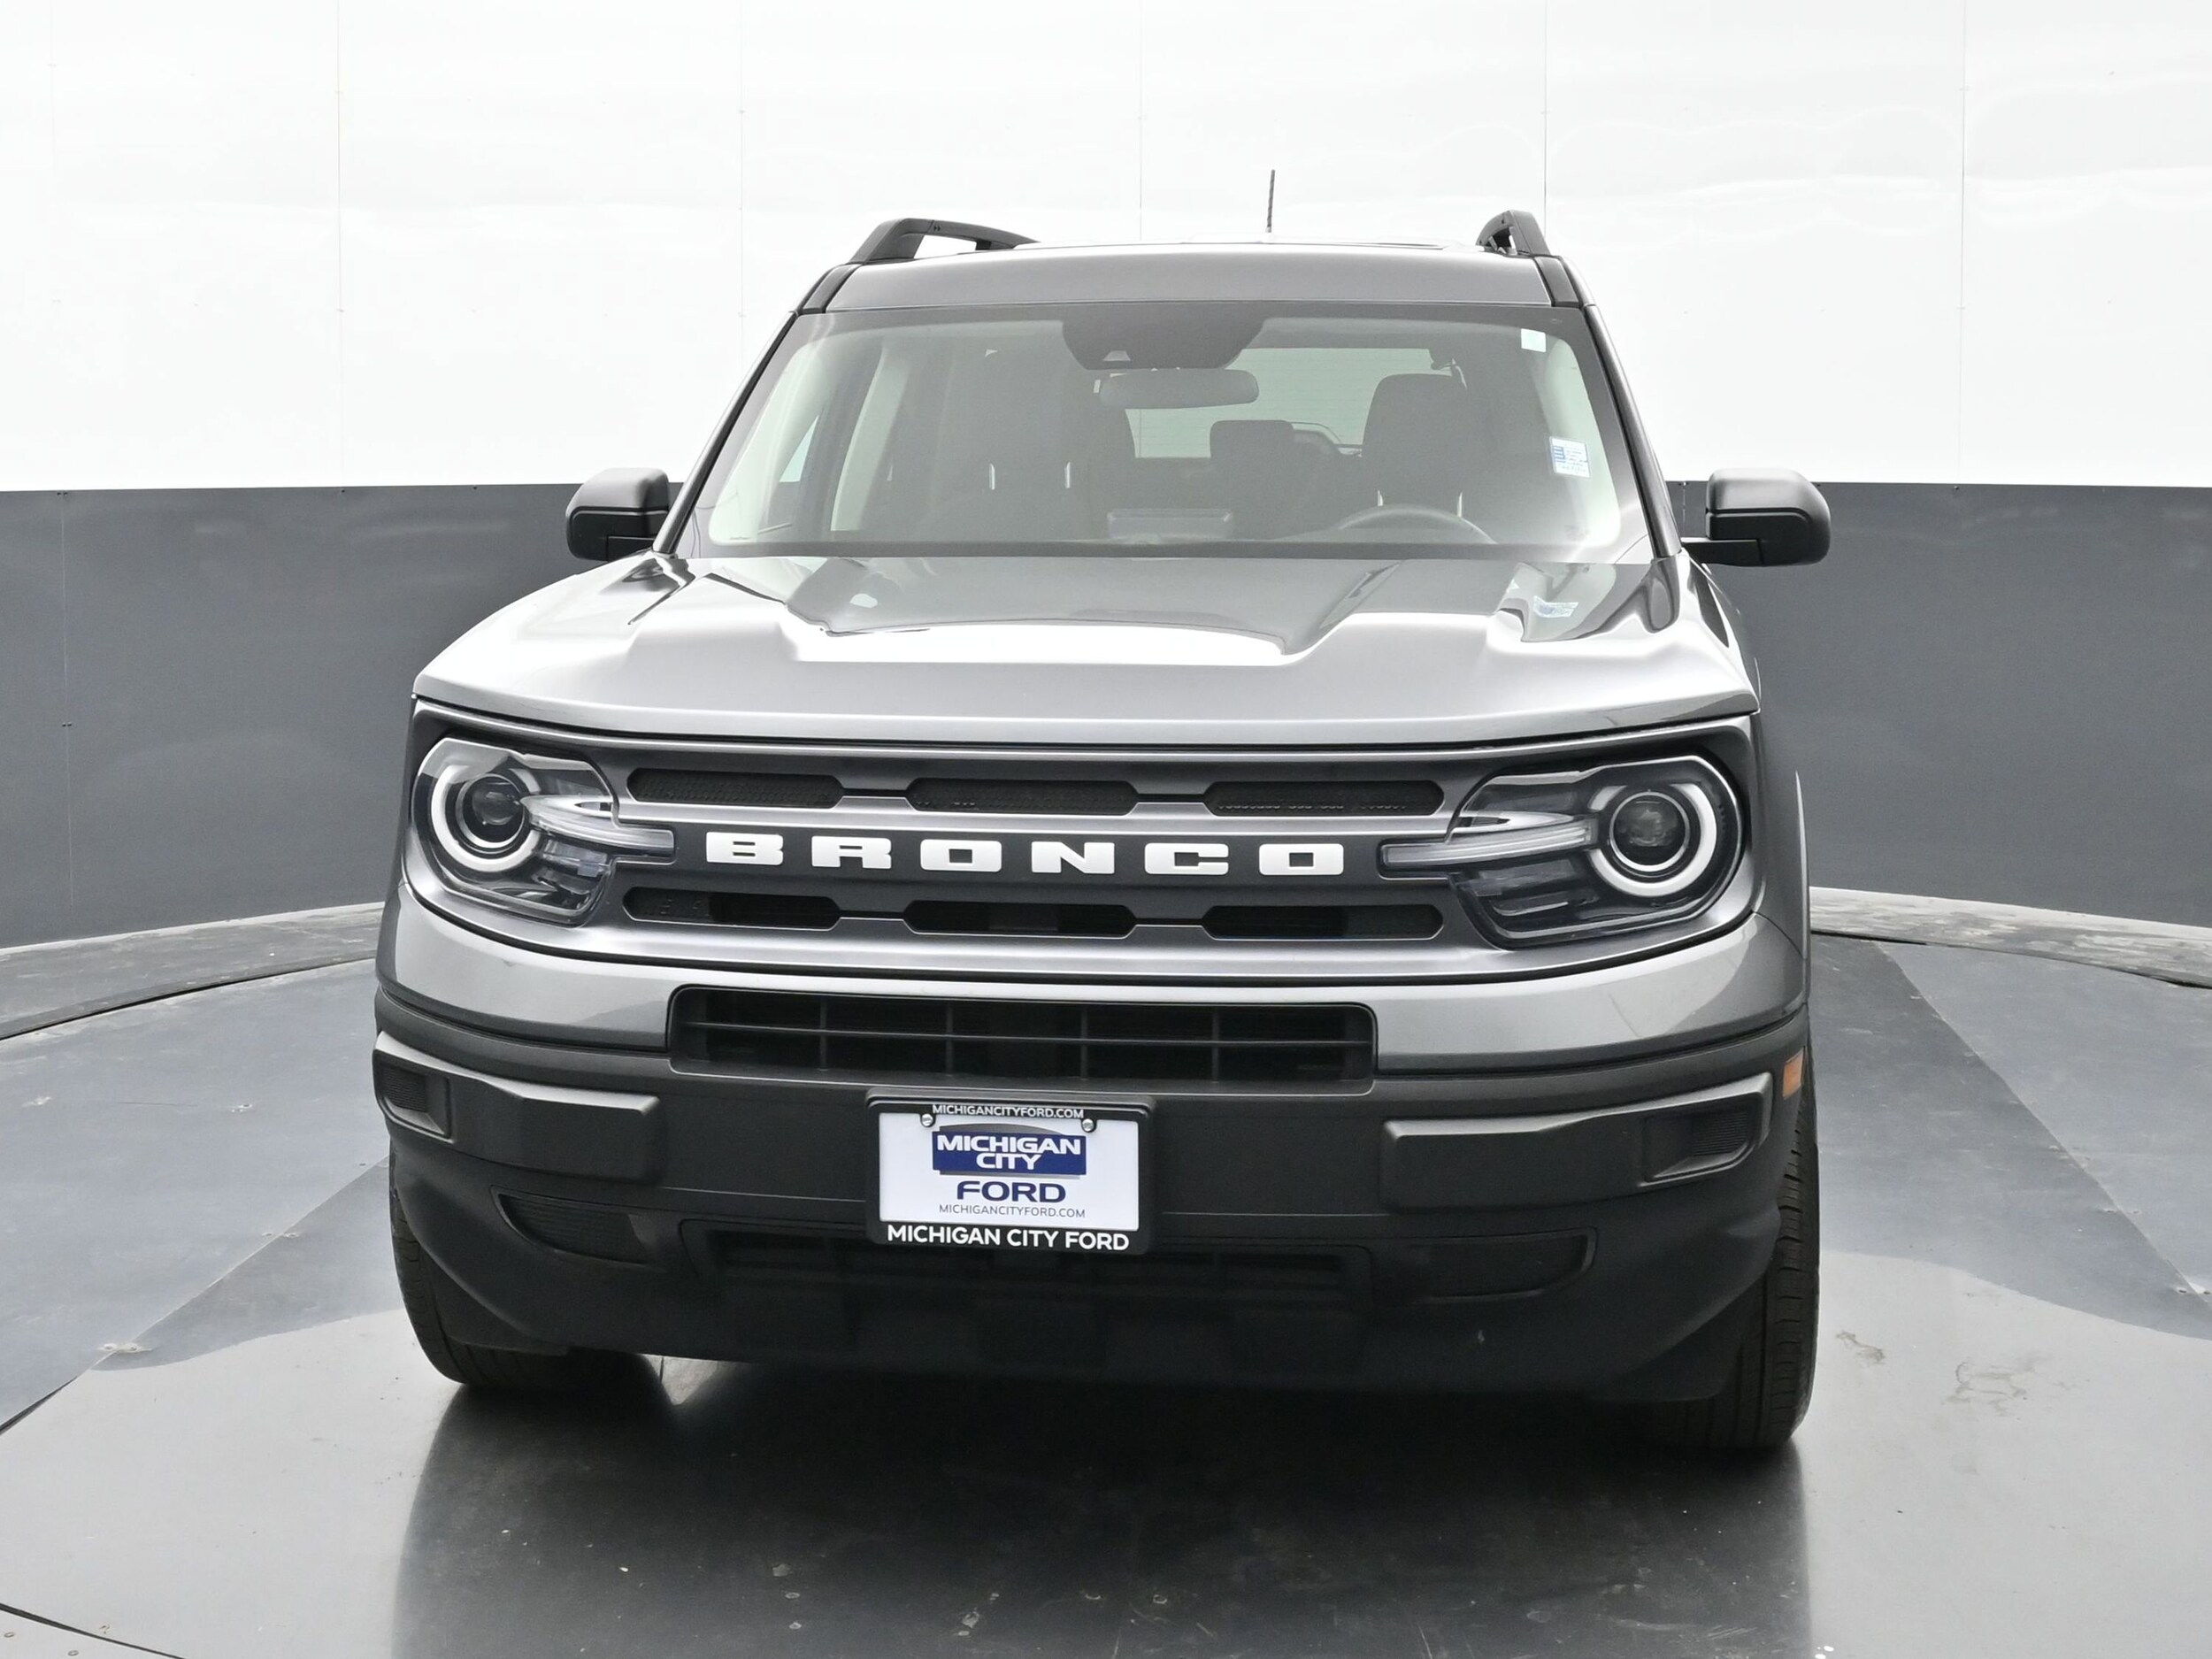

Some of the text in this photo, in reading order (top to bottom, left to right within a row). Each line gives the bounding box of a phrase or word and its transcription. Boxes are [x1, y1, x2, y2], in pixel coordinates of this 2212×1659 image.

[706, 832, 1344, 875] BRONCO
[932, 1103, 1084, 1119] MICHIGANCITYFORD.COM
[937, 1134, 1081, 1155] MICHIGAN
[976, 1153, 1042, 1171] CITY
[956, 1180, 1066, 1203] FORD
[939, 1203, 1085, 1218] MICHIGANCITYFORD.COM
[887, 1224, 1130, 1251] MICHIGAN CITY FORD
